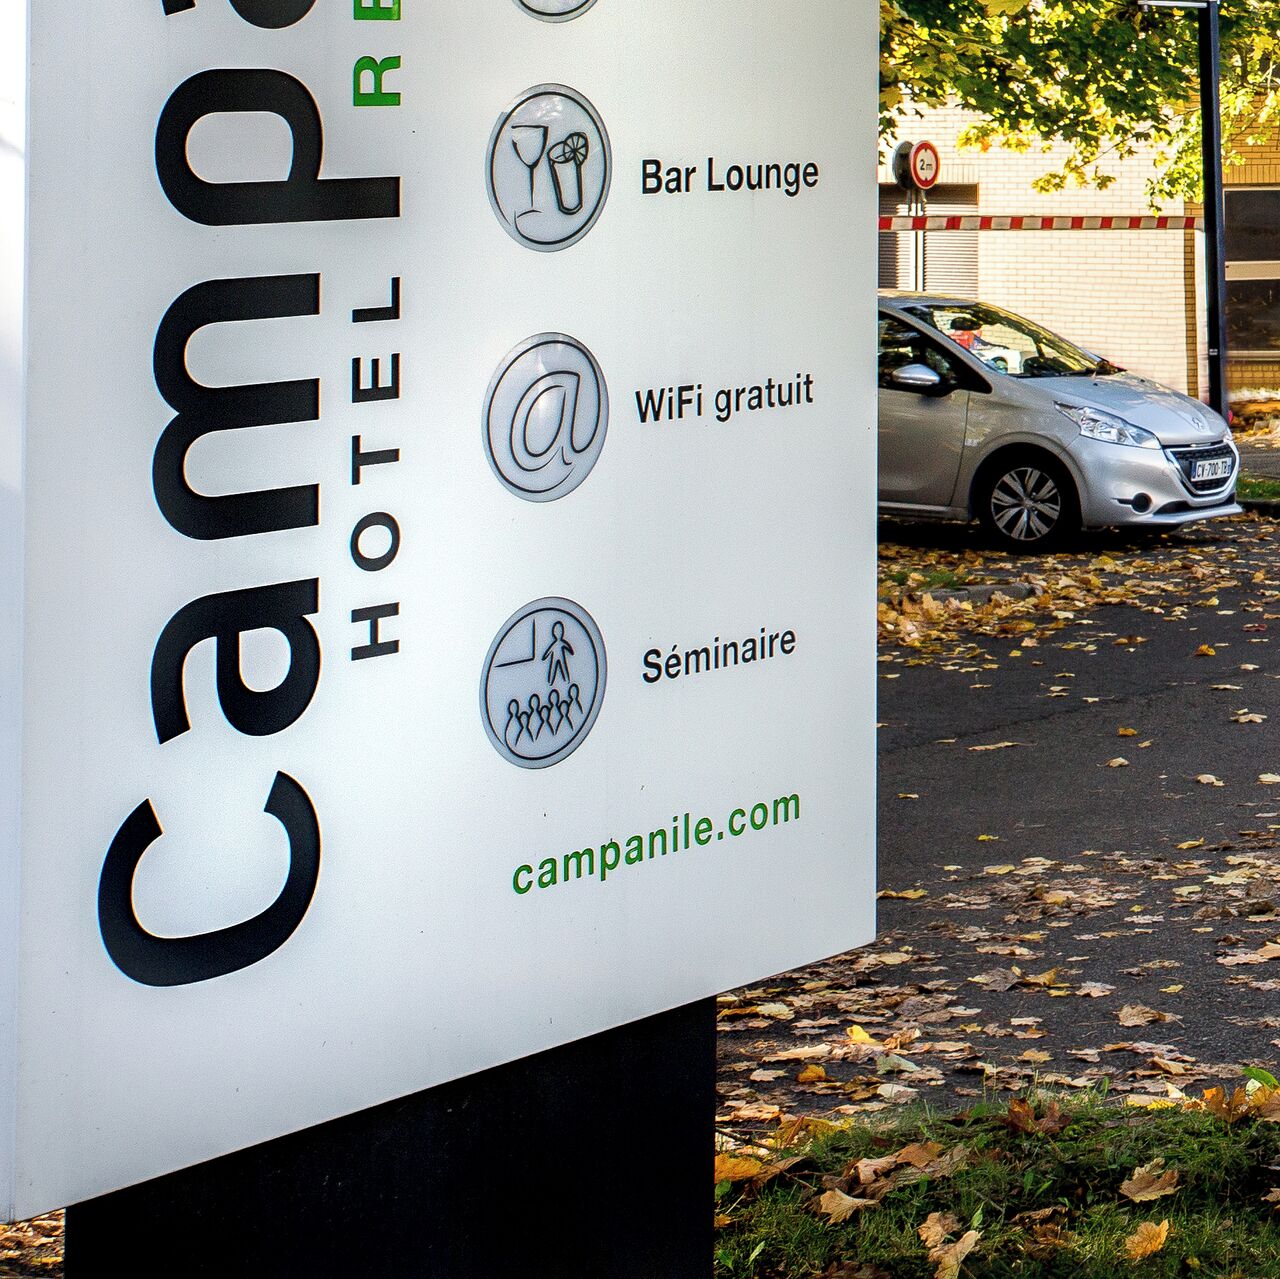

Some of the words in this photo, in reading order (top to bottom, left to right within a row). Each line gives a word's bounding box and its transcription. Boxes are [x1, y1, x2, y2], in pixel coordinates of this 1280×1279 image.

[642, 160, 696, 195] Bar
[707, 157, 819, 198] Lounge
[635, 383, 703, 424] WiFi
[715, 372, 814, 423] gratuit
[350, 277, 400, 661] HOTEL
[642, 627, 796, 684] Séminaire
[512, 793, 800, 895] campanile.com
